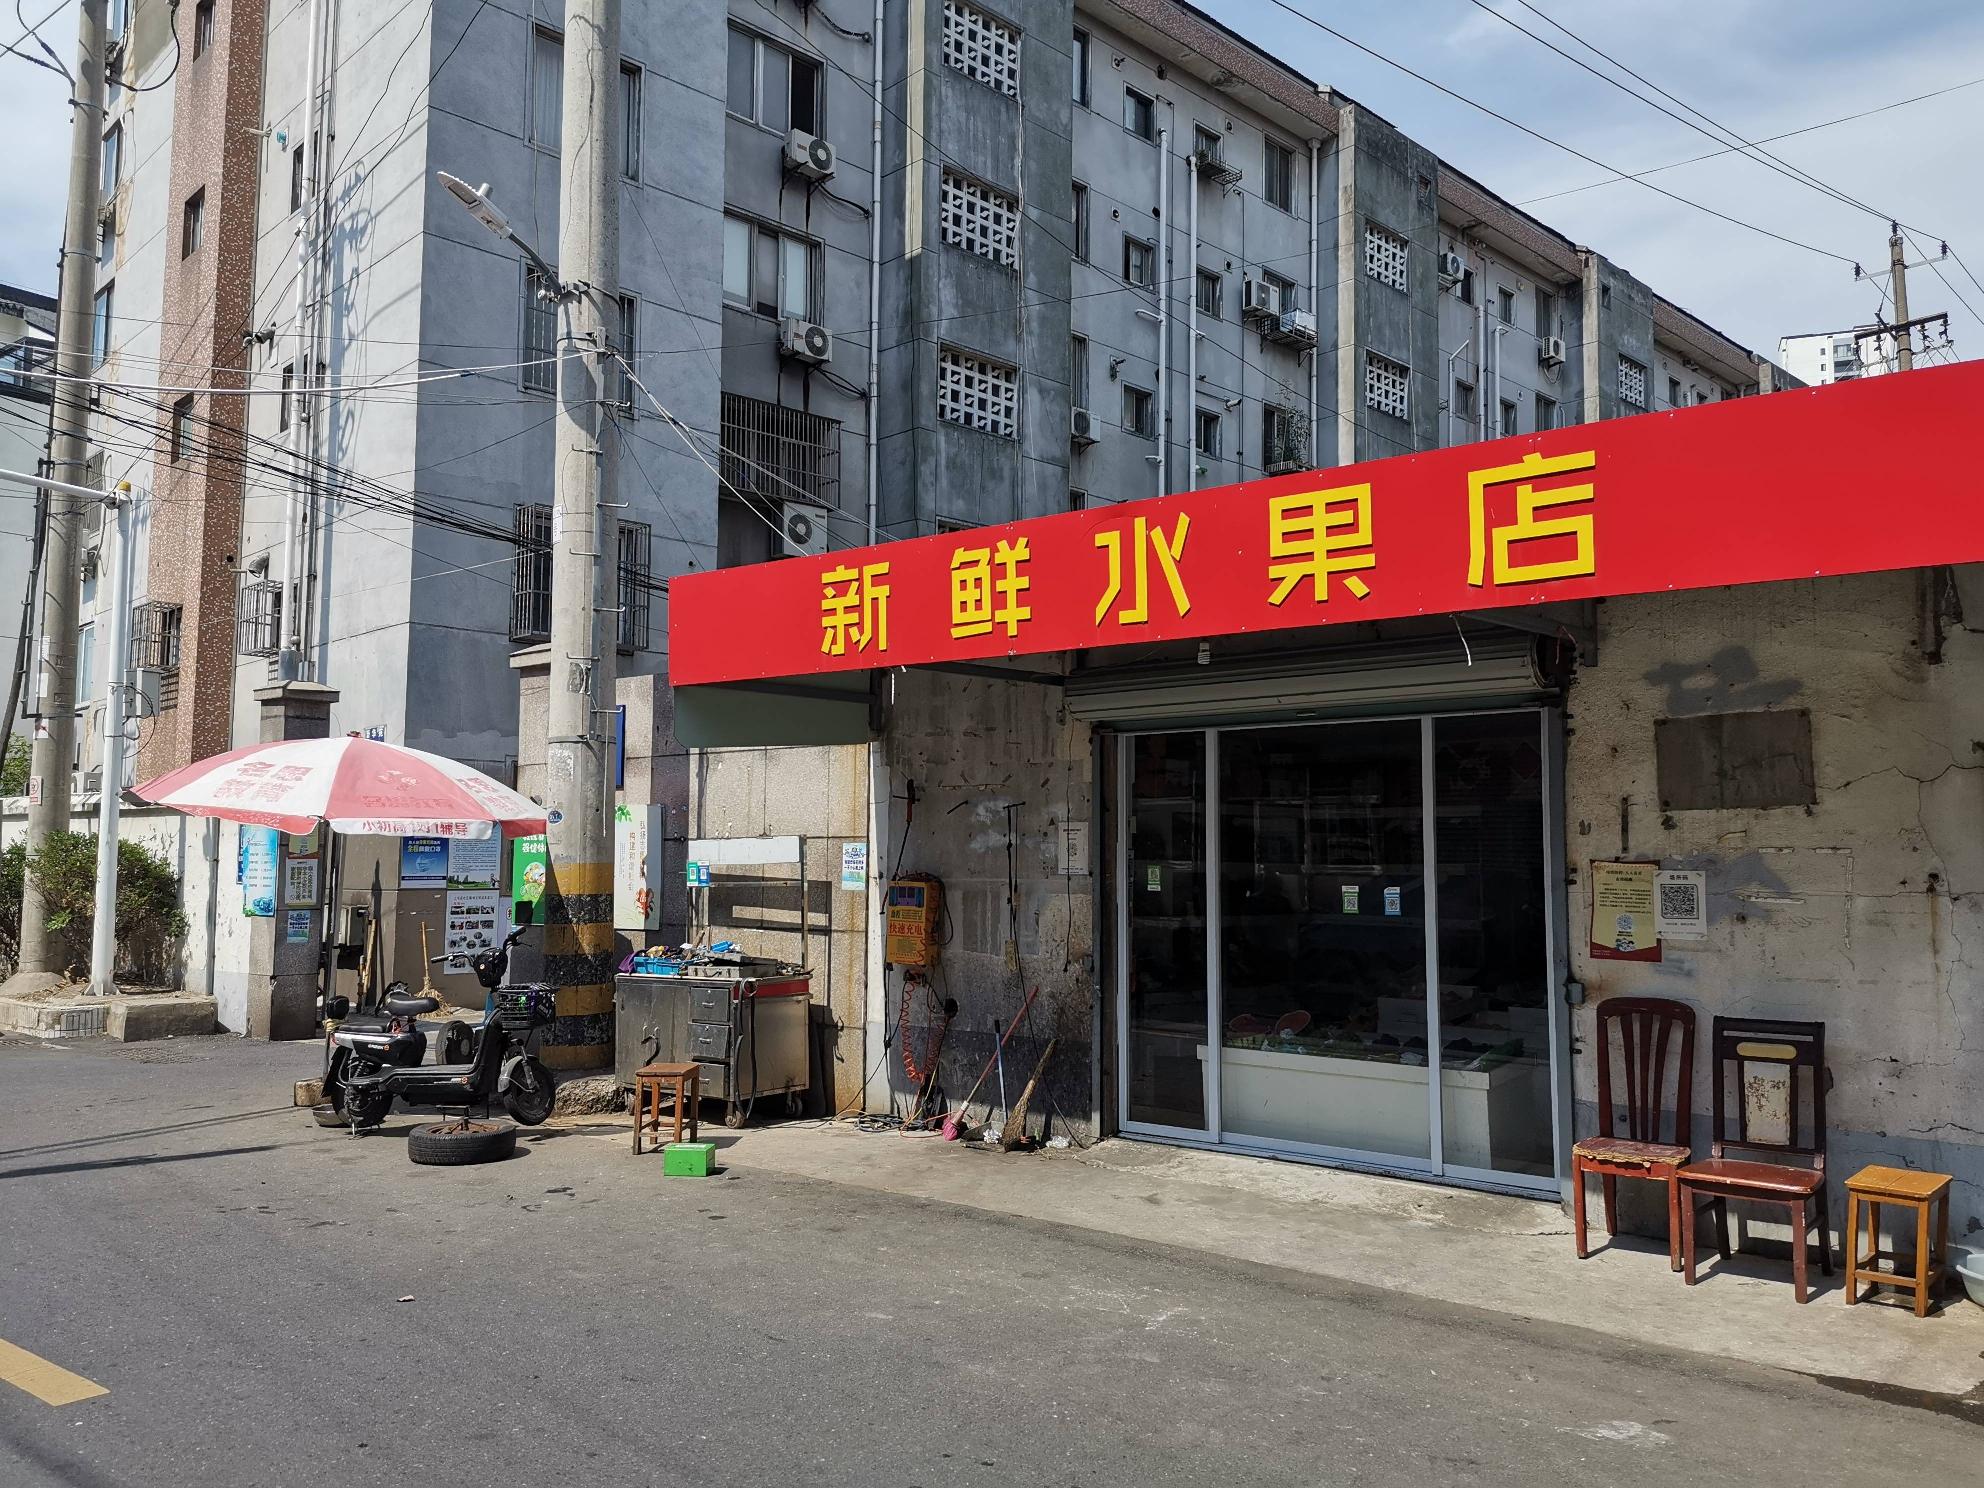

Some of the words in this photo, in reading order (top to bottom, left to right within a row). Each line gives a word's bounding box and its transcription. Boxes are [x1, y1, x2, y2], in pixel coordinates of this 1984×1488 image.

[822, 452, 1594, 654] 新鲜水果店
[889, 922, 923, 936] 快速充电
